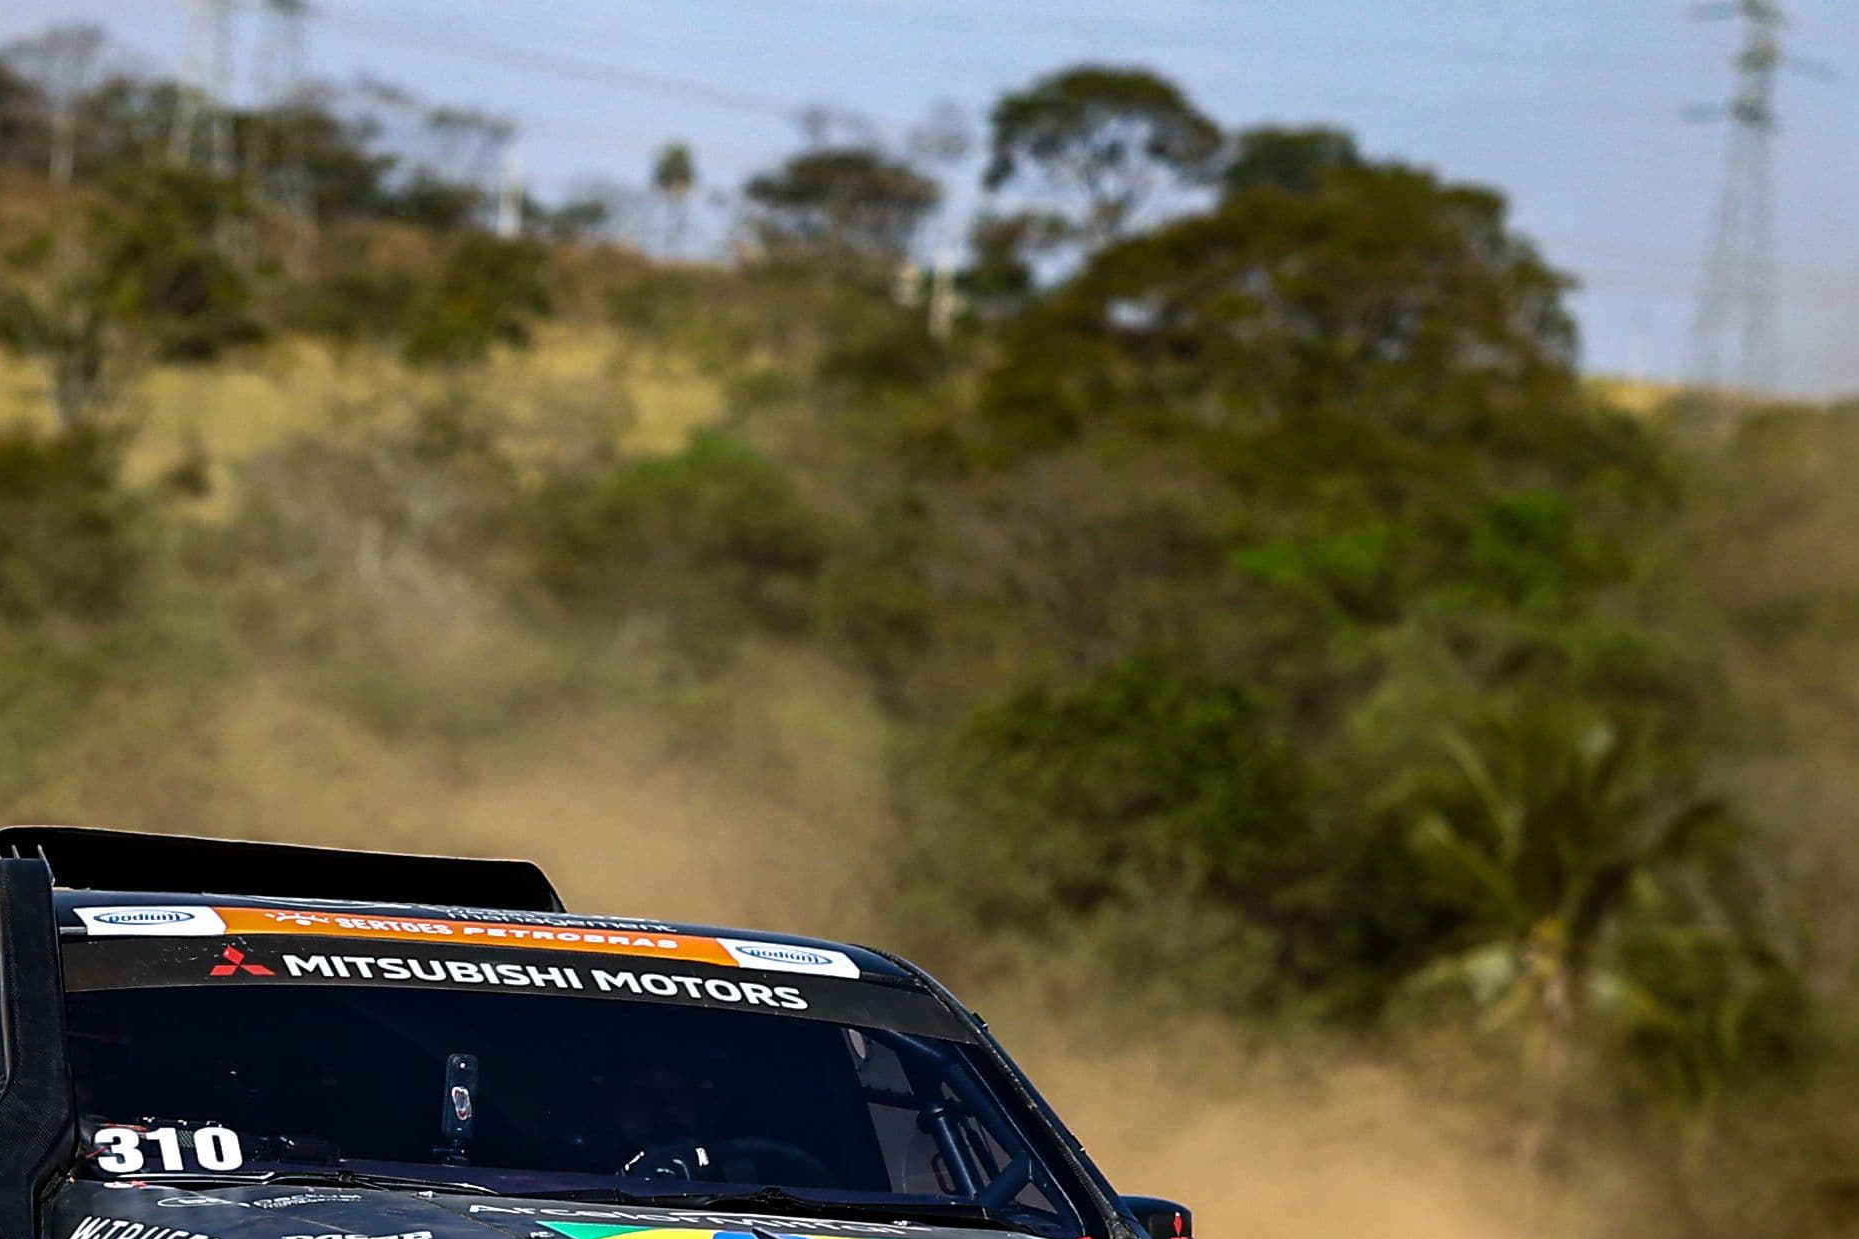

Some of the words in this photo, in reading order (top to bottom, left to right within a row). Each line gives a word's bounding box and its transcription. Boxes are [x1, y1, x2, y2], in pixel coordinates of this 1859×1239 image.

[463, 926, 679, 949] PETROBRAS
[283, 954, 585, 990] MITSUBISHI
[591, 968, 809, 1010] MOTORS
[94, 1126, 243, 1173] 310
[469, 1203, 908, 1235] ArcelorMittal
